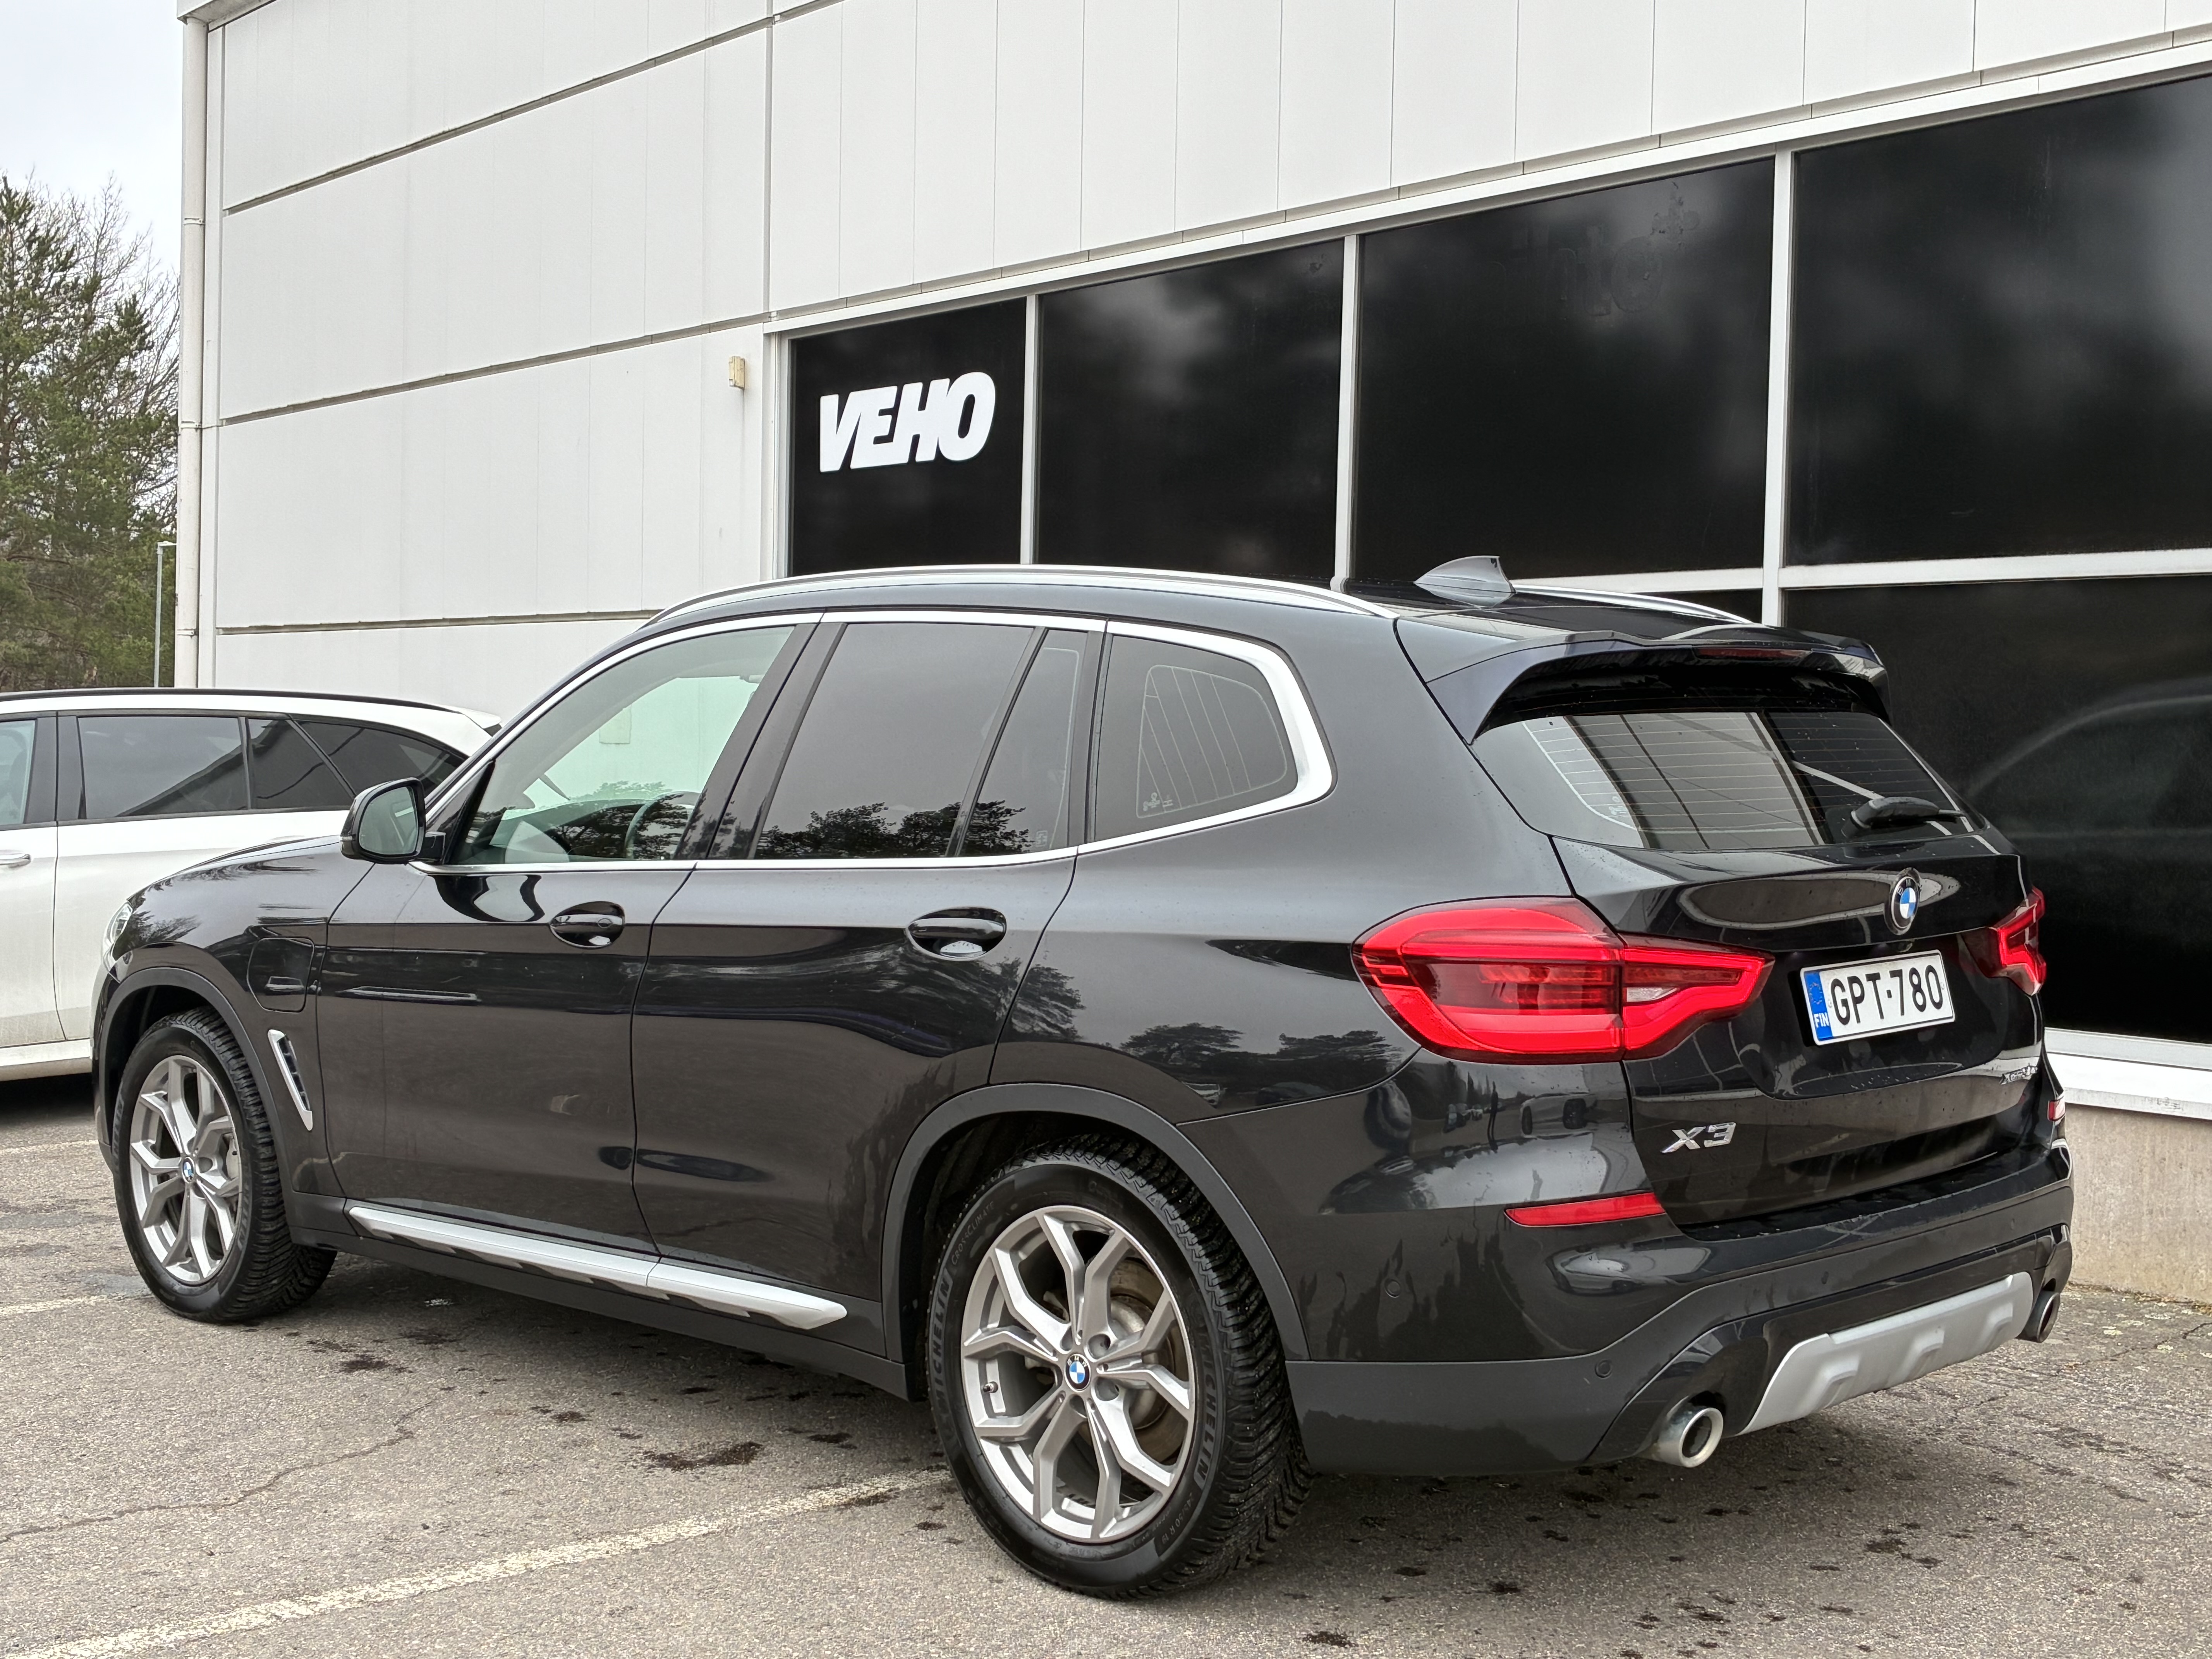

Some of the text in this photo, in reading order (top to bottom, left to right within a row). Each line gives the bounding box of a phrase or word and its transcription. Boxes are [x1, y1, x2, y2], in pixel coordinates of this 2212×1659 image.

[820, 372, 996, 472] VEHO
[1831, 965, 1943, 1025] GPT-780
[1814, 1012, 1830, 1028] FIN
[1661, 1122, 1736, 1153] X3
